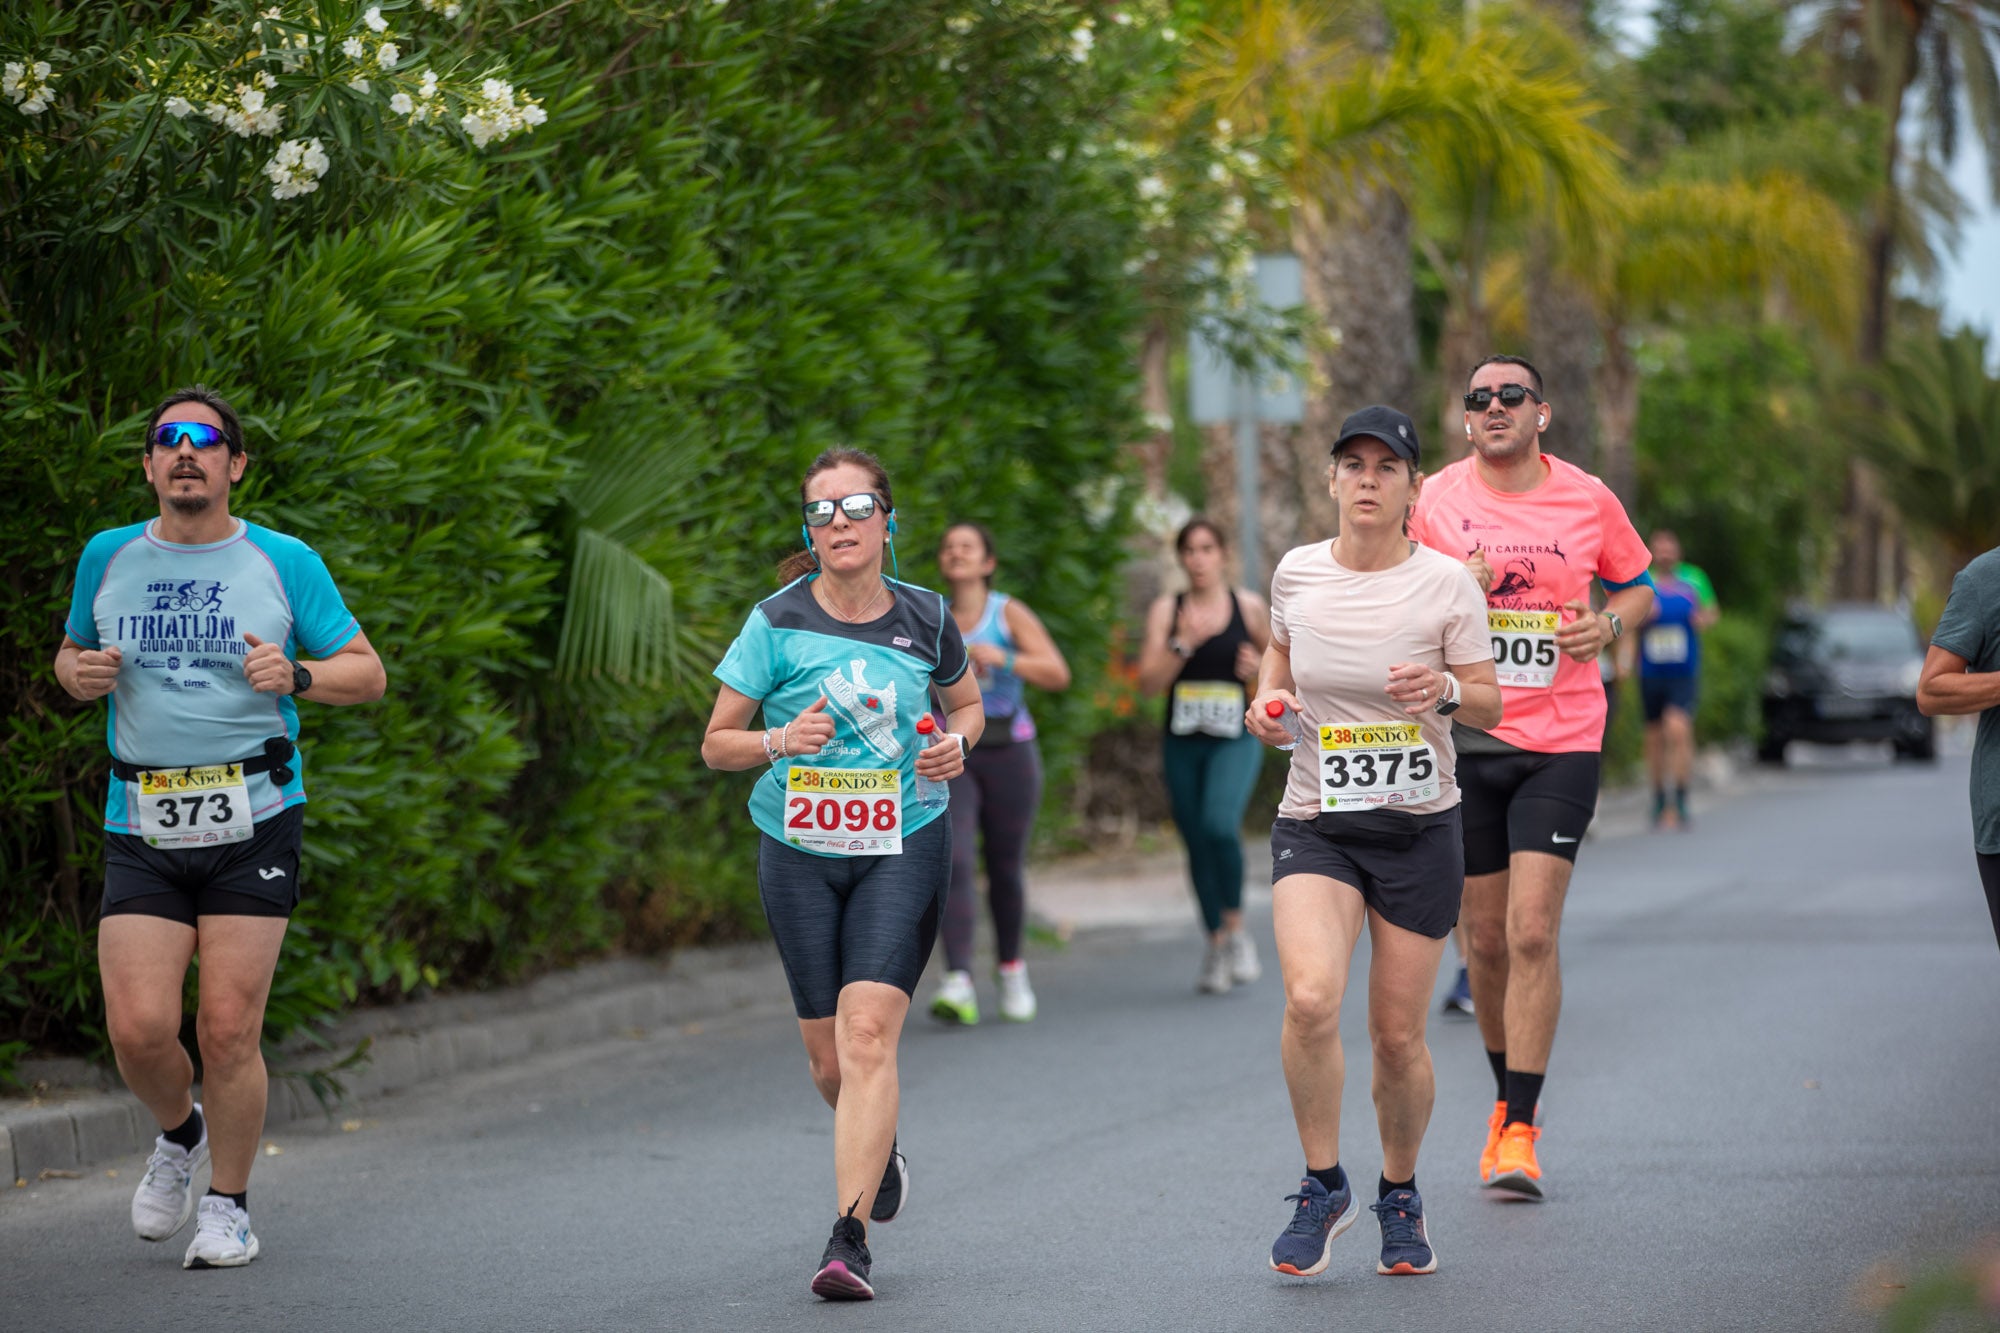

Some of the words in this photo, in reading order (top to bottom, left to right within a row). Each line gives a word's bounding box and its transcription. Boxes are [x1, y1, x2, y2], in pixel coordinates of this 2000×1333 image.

[1496, 545, 1551, 553] CARRERA
[147, 583, 174, 592] 2022
[118, 616, 124, 640] I
[1490, 617, 1541, 629] FONDO
[140, 639, 183, 652] CIUDAD
[187, 639, 202, 652] DE
[204, 640, 248, 655] MOTRIL
[1334, 729, 1352, 743] 38
[1352, 731, 1408, 744] FONDO
[1324, 748, 1433, 788] 3375
[154, 775, 168, 788] 38
[168, 774, 222, 788] FONDO
[803, 771, 820, 786] 38
[820, 777, 877, 789] FONDO
[156, 793, 233, 828] 373
[788, 796, 897, 832] 2098
